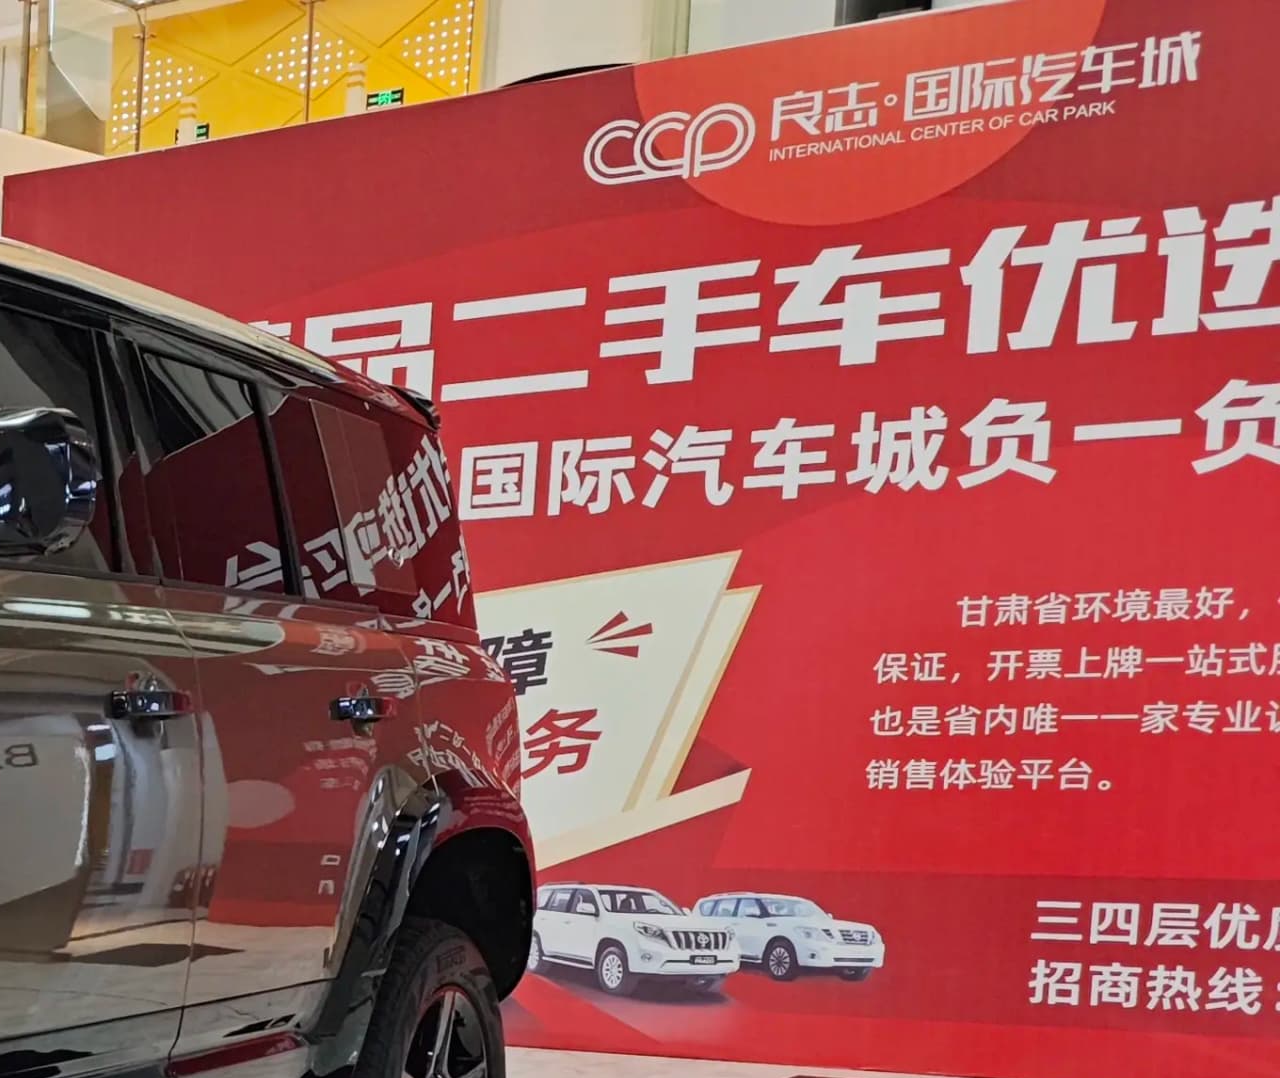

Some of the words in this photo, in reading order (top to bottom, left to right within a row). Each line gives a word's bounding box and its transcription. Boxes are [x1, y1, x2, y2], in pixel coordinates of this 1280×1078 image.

[768, 130, 906, 162] INTERNATIONAL
[910, 118, 985, 142] CENTER
[989, 114, 1015, 130] OF
[1019, 108, 1059, 127] CAR
[1063, 99, 1117, 121] PARK
[246, 194, 1280, 402] 品二手车优选
[457, 378, 1280, 521] 国际汽车城负一负
[521, 708, 602, 779] 务
[869, 699, 1280, 737] 也是省内唯一一家专业
[865, 757, 1114, 791] 销售体验平台。
